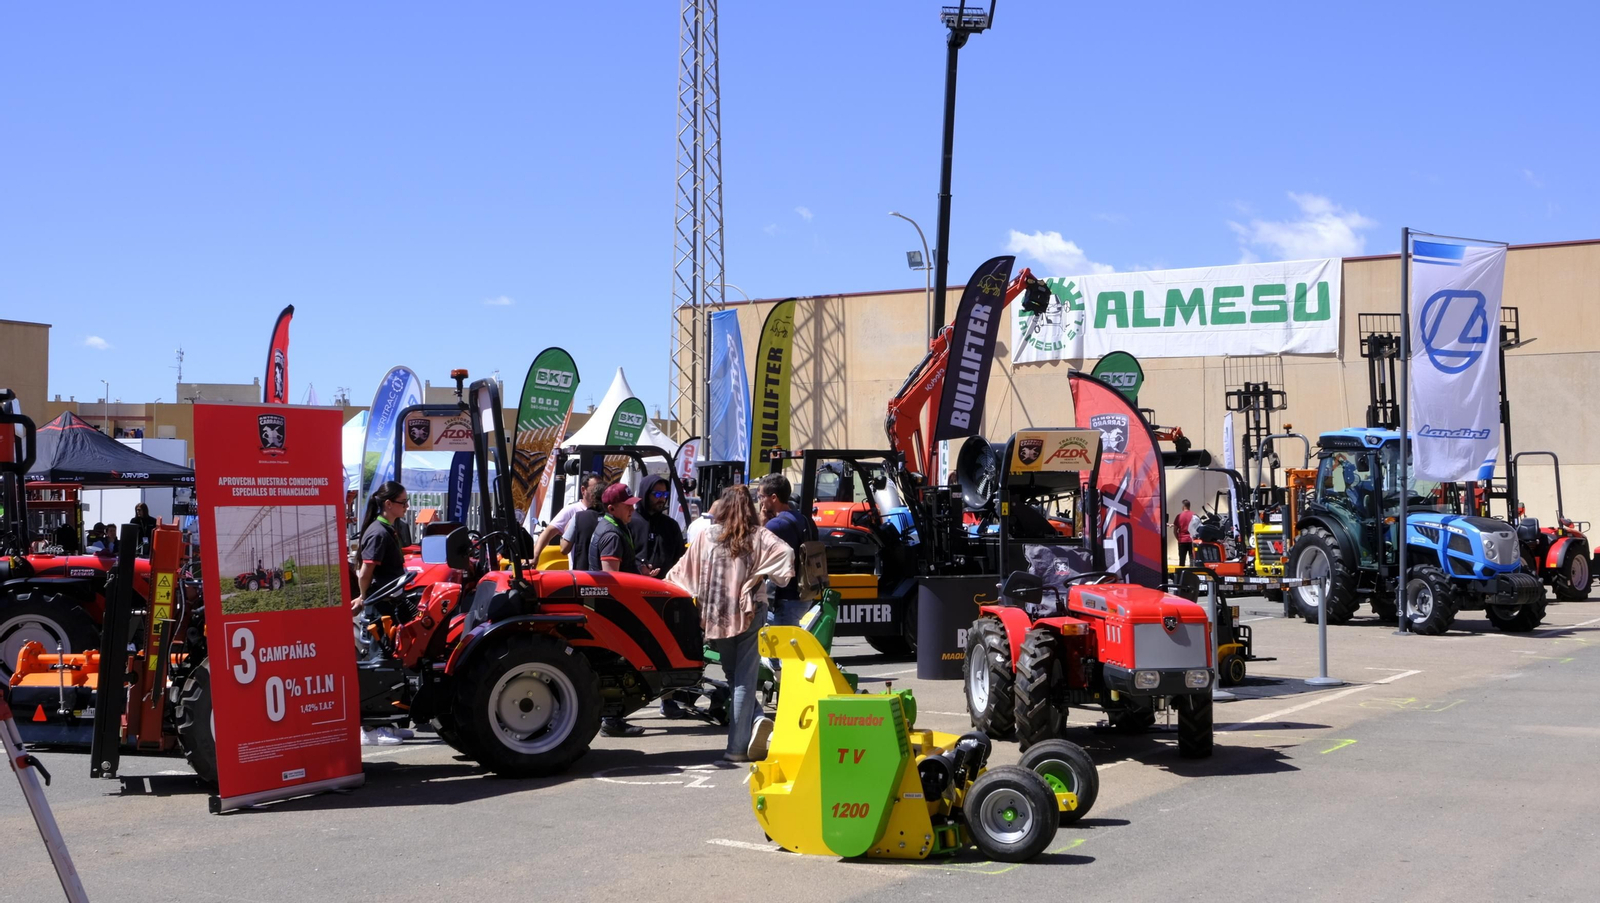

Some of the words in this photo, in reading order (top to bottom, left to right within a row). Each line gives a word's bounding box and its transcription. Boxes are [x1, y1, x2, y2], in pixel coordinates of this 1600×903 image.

[1092, 281, 1331, 329] ALMESU
[950, 303, 992, 430] BULLIFTER
[536, 368, 573, 388] BKT
[925, 368, 945, 392] Kubota
[1100, 372, 1138, 387] BKT
[759, 348, 783, 463] BULLIFTER
[618, 411, 643, 425] BKT
[434, 429, 475, 445] AZOR
[1417, 424, 1490, 440] Landini
[1058, 436, 1088, 445] TRACTORES
[1044, 449, 1092, 464] AZOR
[218, 477, 256, 486] APROVECHA
[257, 477, 288, 486] NUESTRAS
[289, 478, 328, 486] CONDICIONES
[232, 487, 268, 496] ESPECIALES
[269, 487, 277, 496] DE
[278, 486, 320, 497] FINANCIACIÓN
[836, 604, 892, 623] LLIFTER
[232, 627, 257, 684] 3
[258, 640, 316, 662] CAMPAÑAS
[304, 674, 334, 695] T.I.N
[300, 704, 318, 714] 1,42%
[828, 714, 885, 726] Triturador
[832, 802, 870, 818] 1200
